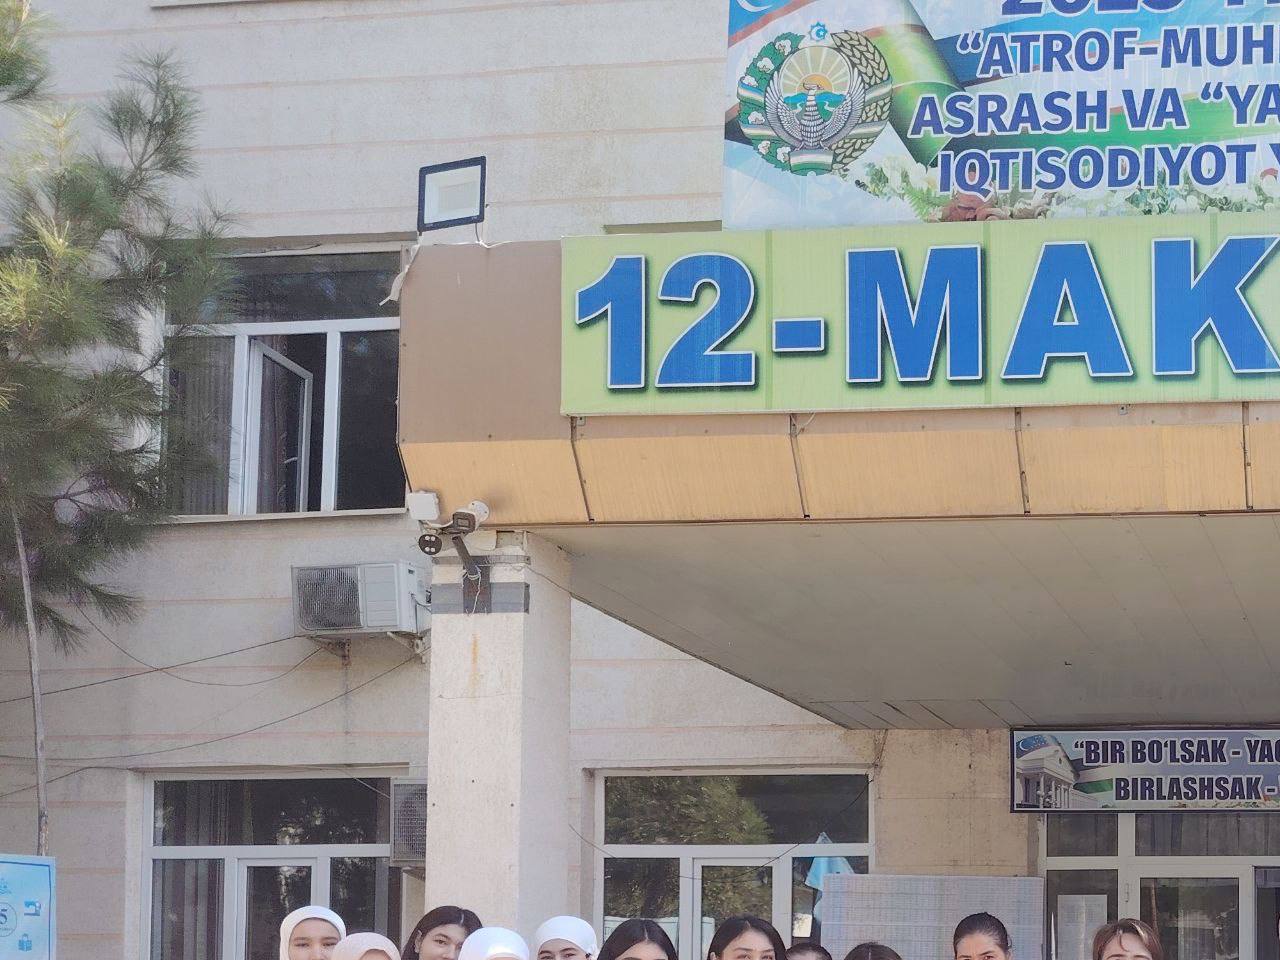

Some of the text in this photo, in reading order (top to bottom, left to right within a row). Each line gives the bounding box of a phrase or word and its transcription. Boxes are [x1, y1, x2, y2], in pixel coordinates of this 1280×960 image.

[908, 89, 1108, 136] ASRASH
[1121, 86, 1188, 130] VA
[938, 143, 1256, 199] IQTISODIYOT
[1074, 740, 1125, 764] “BIR
[1115, 777, 1262, 801] BIRLASHSAK
